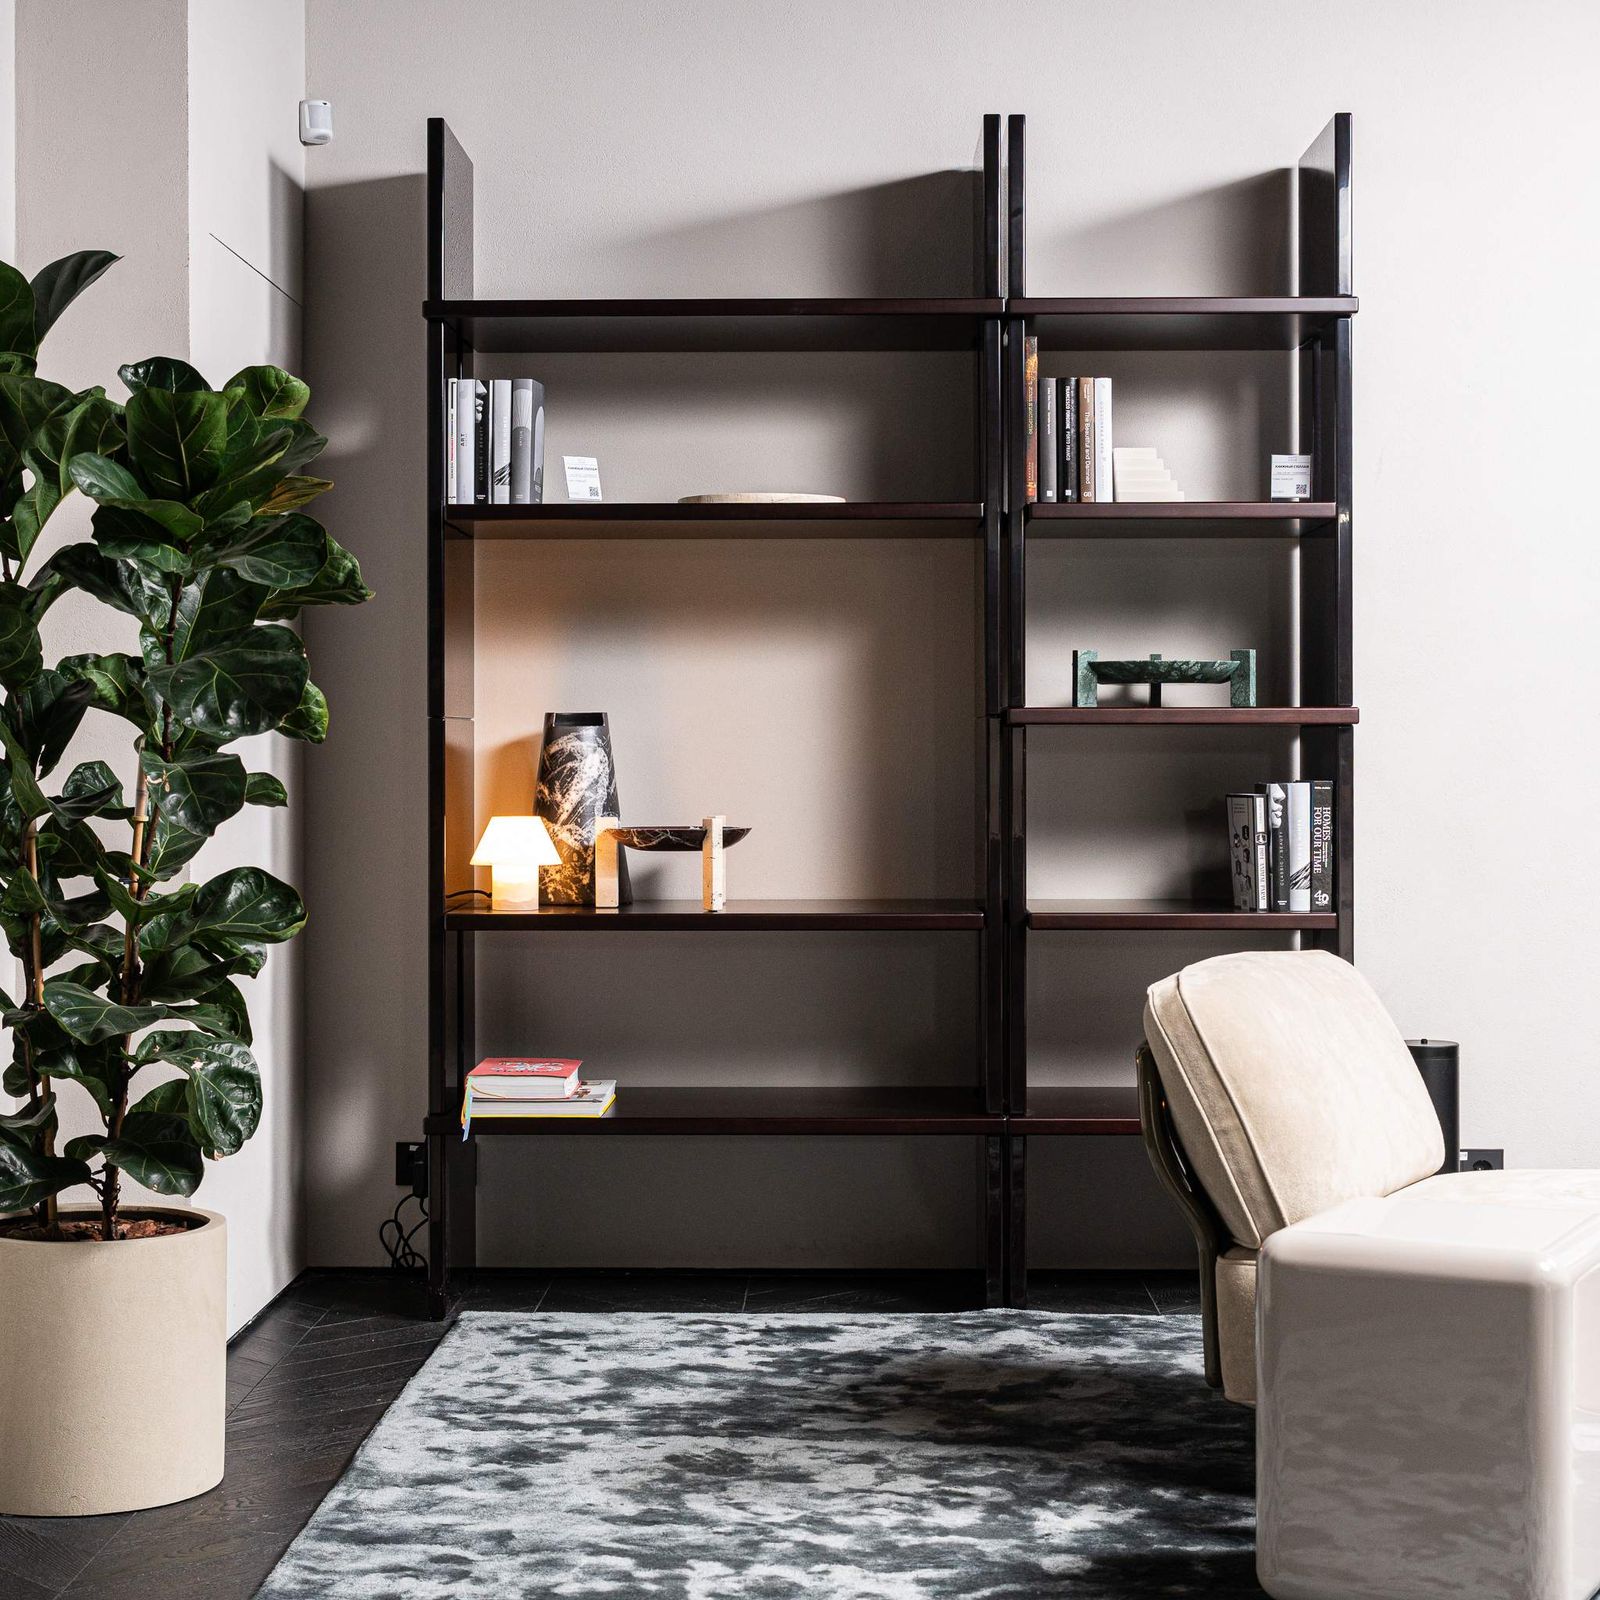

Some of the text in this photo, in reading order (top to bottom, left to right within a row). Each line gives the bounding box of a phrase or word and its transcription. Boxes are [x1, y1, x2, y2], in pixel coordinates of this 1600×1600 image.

[1313, 806, 1322, 874] FOR OUR TIME
[1322, 806, 1331, 841] HOMES
